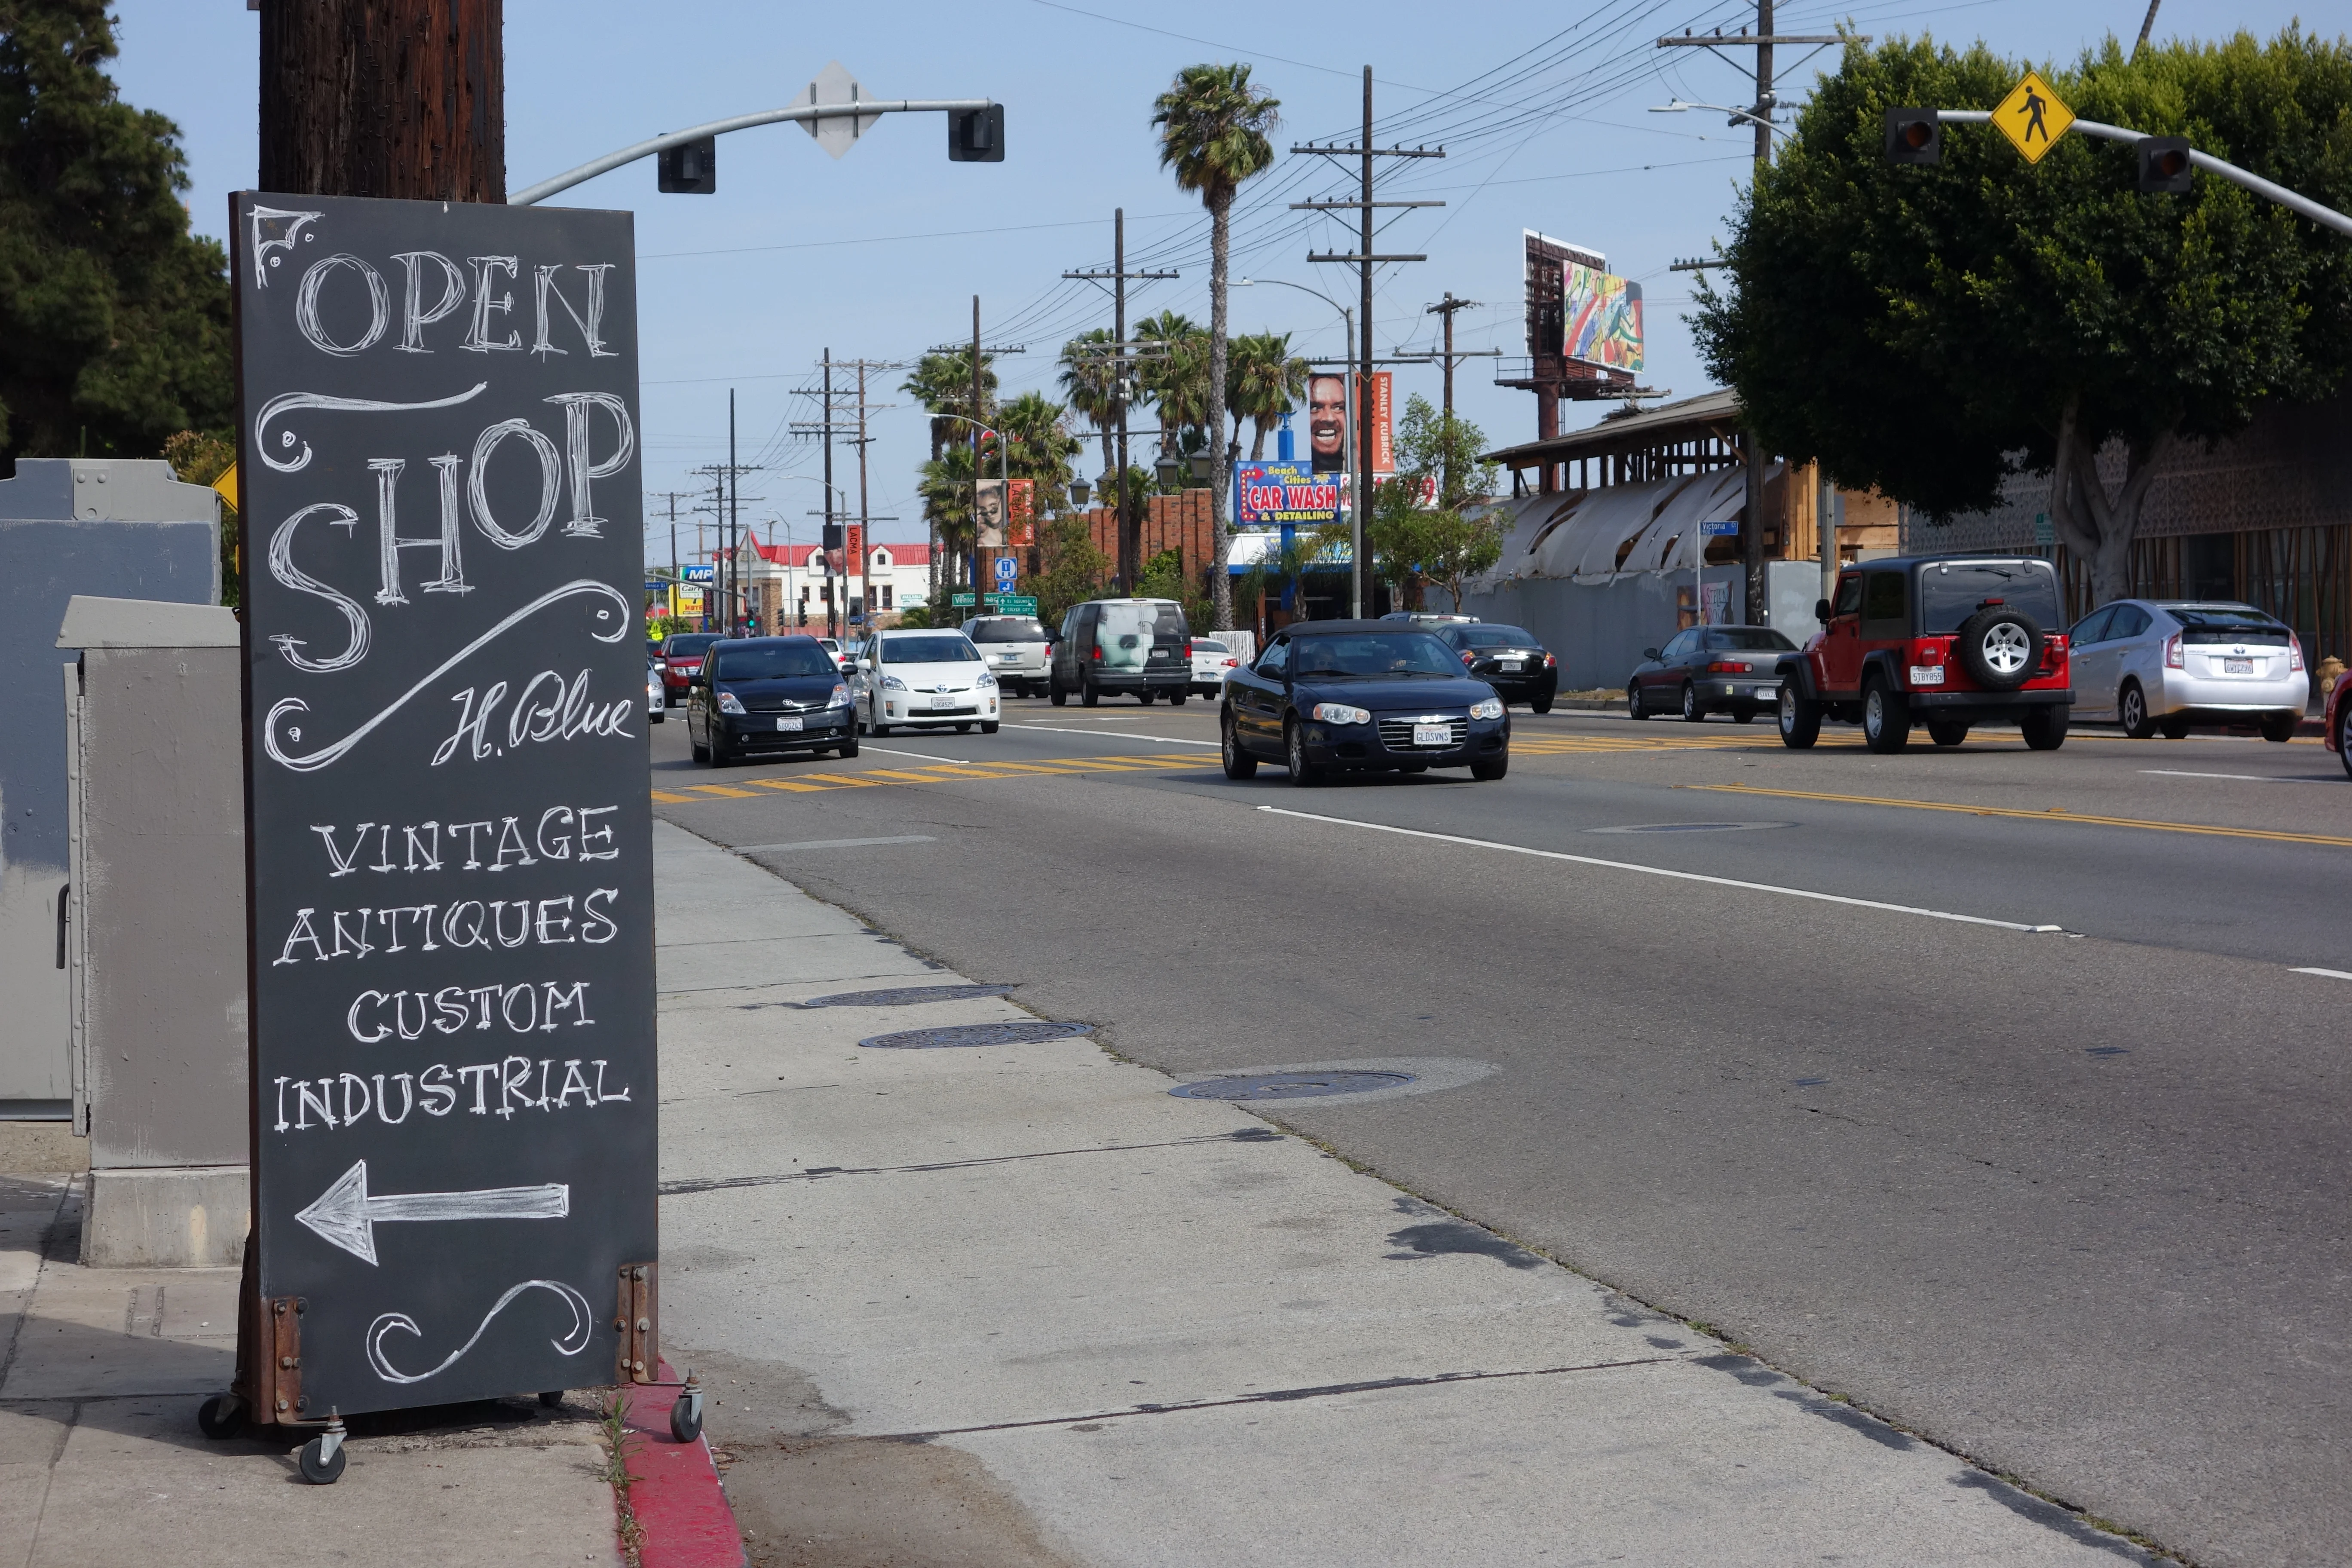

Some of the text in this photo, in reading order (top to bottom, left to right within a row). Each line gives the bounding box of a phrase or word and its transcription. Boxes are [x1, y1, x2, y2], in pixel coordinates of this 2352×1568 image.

[296, 251, 619, 362] OPEN
[1380, 421, 1390, 464] KUBRICK
[1268, 466, 1297, 475] Beach
[1284, 475, 1311, 484] Cities
[1250, 485, 1283, 510] CAR
[1286, 485, 1337, 510] WASH
[1261, 511, 1334, 521] & DETAILING
[269, 392, 634, 672] SHOP
[849, 527, 858, 554] LACMA
[1913, 672, 1942, 681] 5TBY855
[510, 667, 635, 748] Blue
[1417, 732, 1449, 741] GLDSVNS
[310, 805, 619, 877] VINTAGE
[273, 888, 619, 966] ANTIQUES
[347, 982, 596, 1043] CUSTOM
[273, 1055, 632, 1134] INDUSTRIAL
